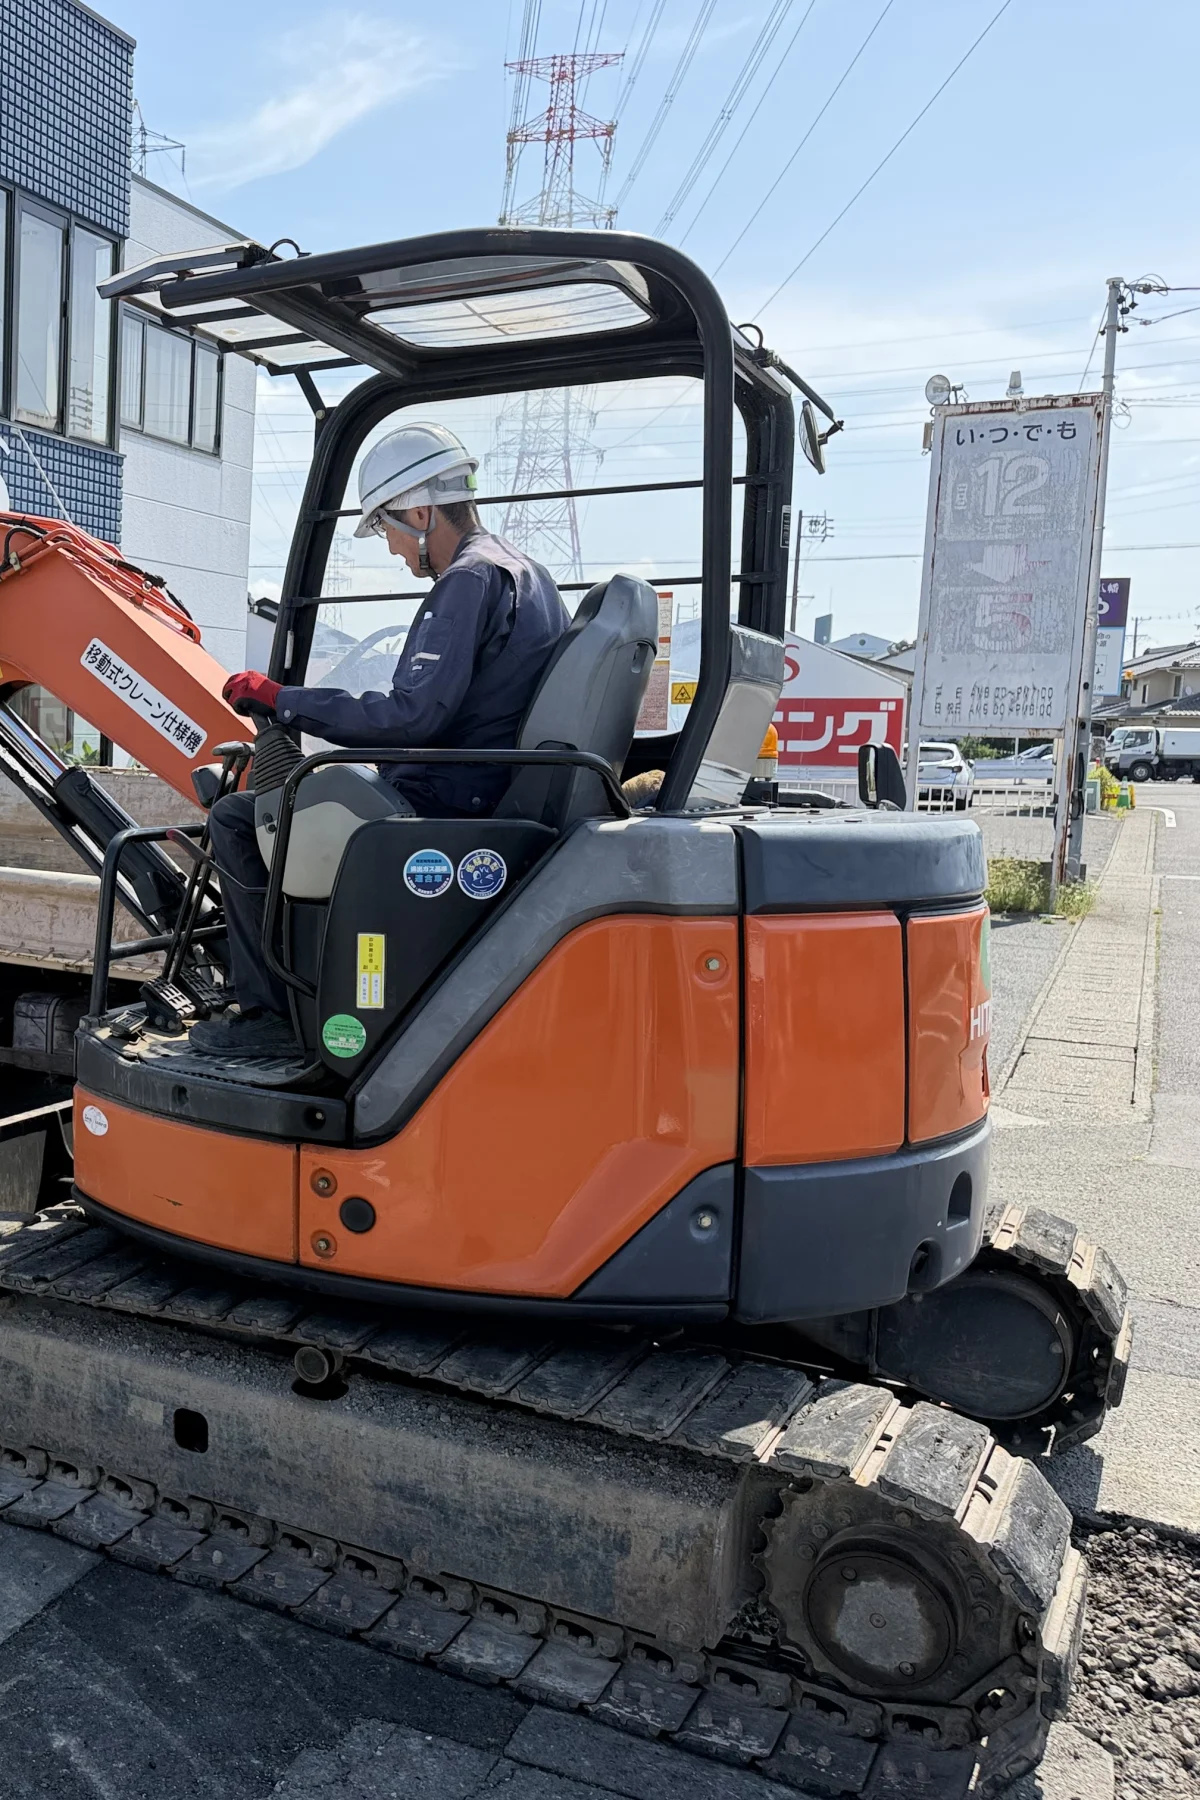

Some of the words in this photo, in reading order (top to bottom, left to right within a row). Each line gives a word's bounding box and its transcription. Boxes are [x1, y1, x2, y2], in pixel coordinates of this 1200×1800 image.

[975, 455, 1050, 517] 12
[84, 643, 203, 753] 移動式クレーン仕様機
[772, 701, 896, 754] ング
